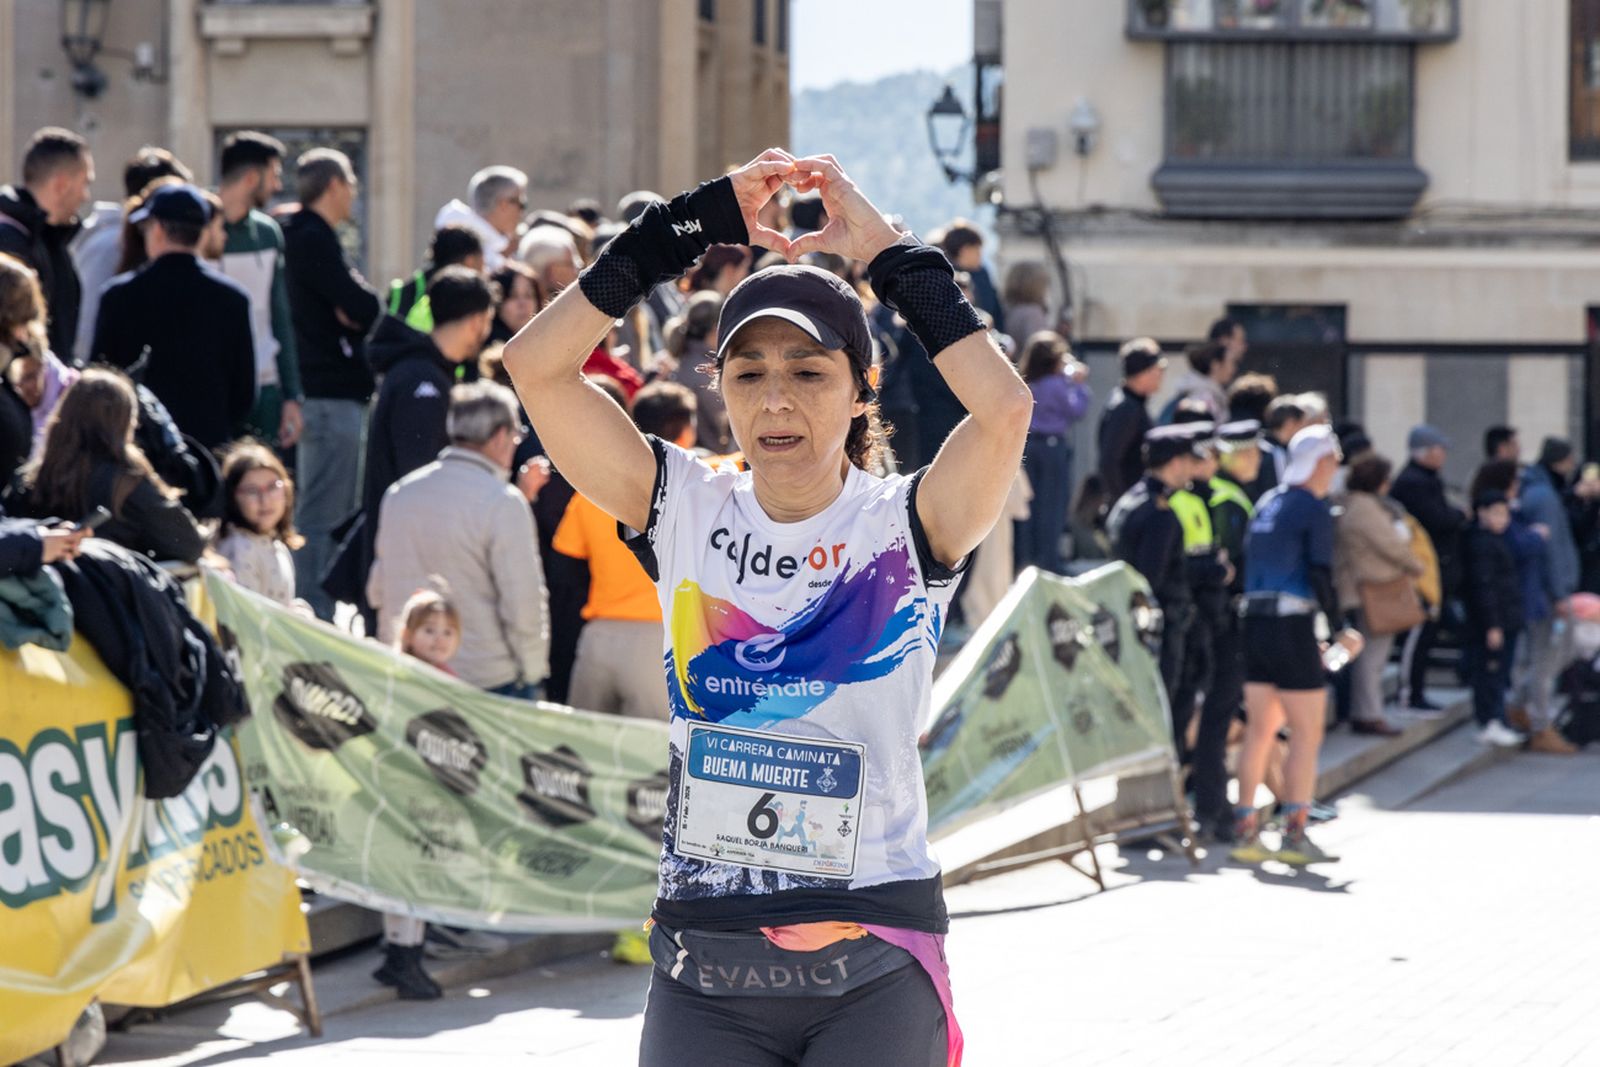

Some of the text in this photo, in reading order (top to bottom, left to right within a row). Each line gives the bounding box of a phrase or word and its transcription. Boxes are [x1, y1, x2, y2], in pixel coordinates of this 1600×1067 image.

[808, 579, 832, 588] desde
[704, 675, 825, 697] entrénate
[706, 737, 841, 765] VI CARRERA CAMINATA
[703, 755, 809, 788] BUENA MUERTE
[747, 792, 778, 838] 6
[744, 839, 767, 848] BORJA
[769, 842, 807, 852] BANQUERI
[699, 954, 848, 988] EVADICT
